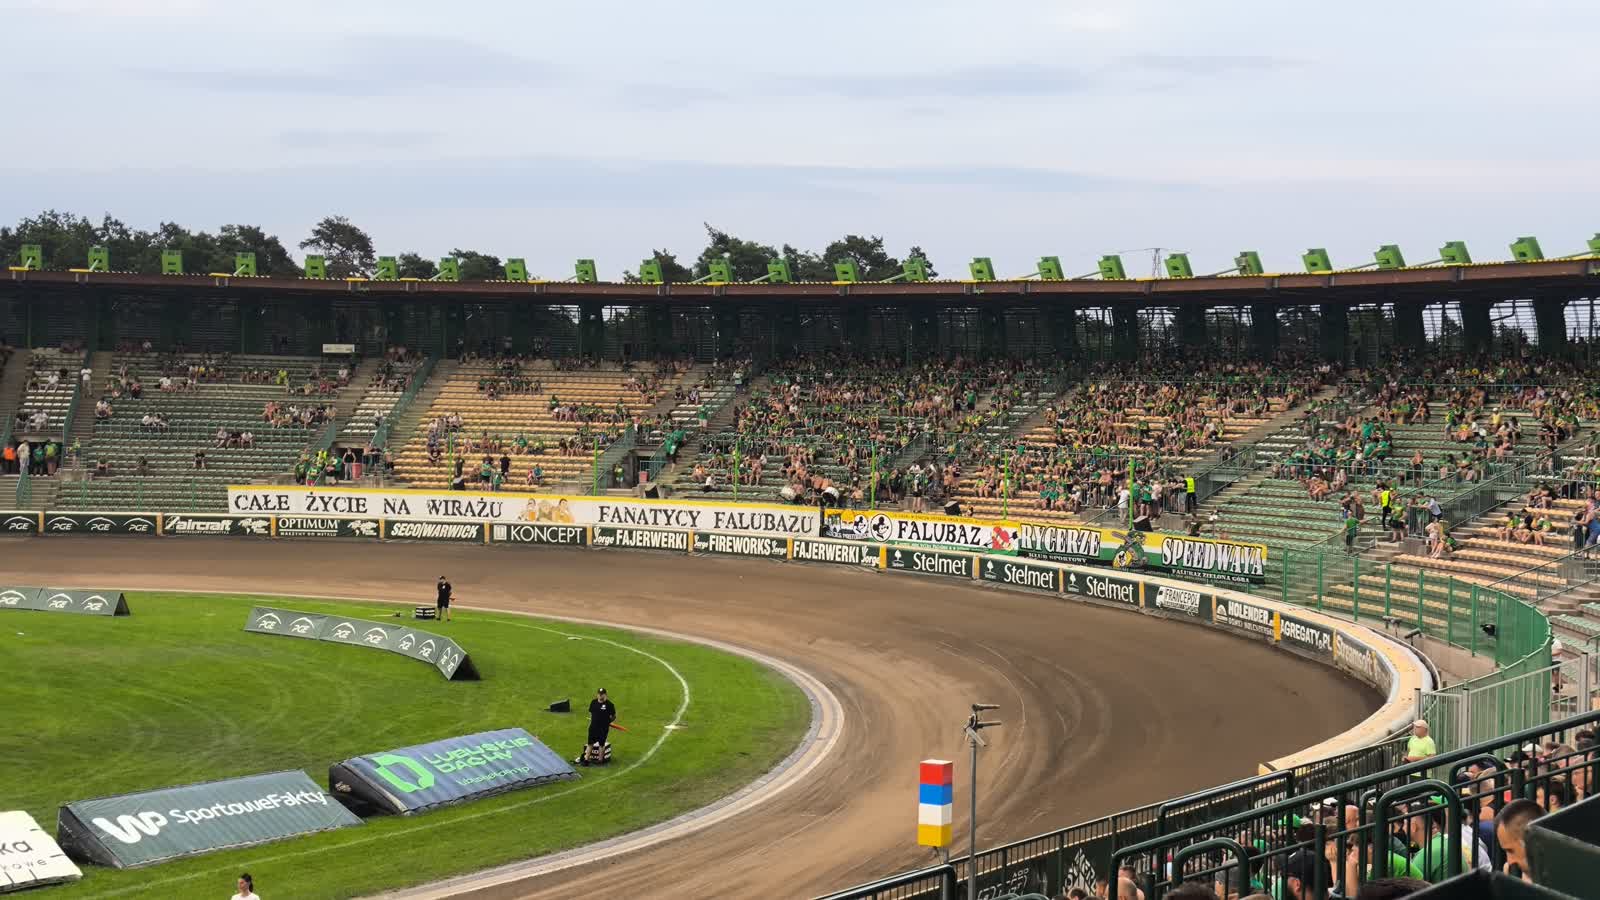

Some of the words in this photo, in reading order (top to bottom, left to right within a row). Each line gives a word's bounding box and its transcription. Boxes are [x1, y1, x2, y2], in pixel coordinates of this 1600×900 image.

[234, 494, 290, 511] CAŁE
[305, 491, 368, 514] ŻYCIE
[383, 498, 411, 515] NA
[426, 497, 503, 518] WIRAŻU
[8, 522, 29, 530] PGE
[52, 523, 73, 531] PGE
[90, 523, 111, 531] PGE
[128, 524, 149, 532] PGE
[278, 518, 338, 529] OPTIMUM
[598, 505, 701, 528] FANATYCY
[714, 511, 814, 534] FALUBAZU
[510, 526, 583, 543] KONCEPT
[616, 529, 687, 549] FAJERWERKI
[897, 520, 981, 546] FALUBAZ
[709, 534, 771, 556] FIREWORKS
[793, 541, 859, 563] FAJERWERKI
[913, 552, 967, 575] Stelmet
[1161, 537, 1264, 576] SPEEDWAYA
[1004, 563, 1054, 589] Stelmet
[1086, 576, 1134, 603] Stelmet
[169, 791, 330, 825] SportoweFakty
